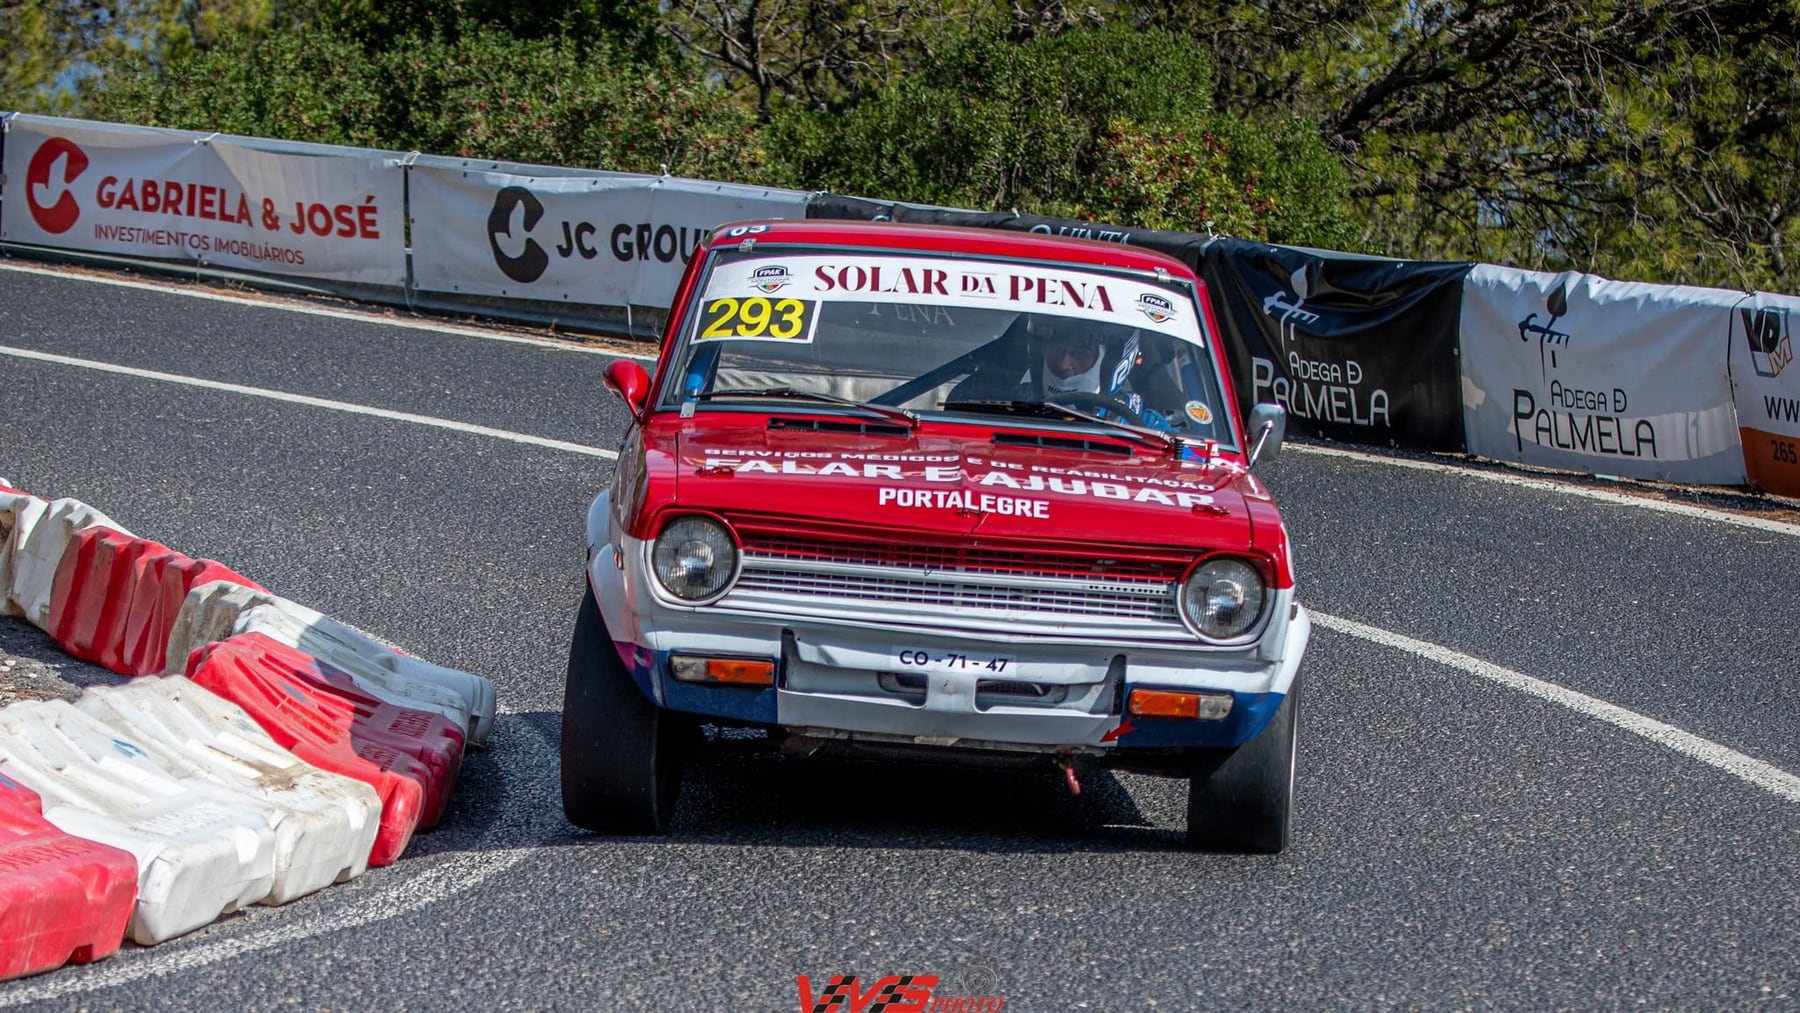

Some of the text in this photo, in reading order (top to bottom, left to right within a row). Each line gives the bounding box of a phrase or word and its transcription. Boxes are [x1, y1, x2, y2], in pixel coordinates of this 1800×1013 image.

[96, 176, 380, 239] GABRIELA & JOSÉ
[94, 224, 304, 265] INVESTIMENTOS IMOBILIÁRIOS
[556, 221, 709, 265] JC GROU
[814, 265, 949, 296] SOLAR
[961, 275, 995, 294] DA
[1010, 275, 1114, 313] PENA
[701, 297, 805, 340] 293
[1289, 351, 1341, 384] ADEGA
[1251, 356, 1391, 428] PALMELA
[1551, 379, 1607, 412] ADEGA
[1513, 388, 1657, 458] PALMELA
[1771, 440, 1798, 465] 265
[706, 458, 1215, 508] FALAR E AJUDAR
[879, 488, 1050, 519] PORTALEGRE
